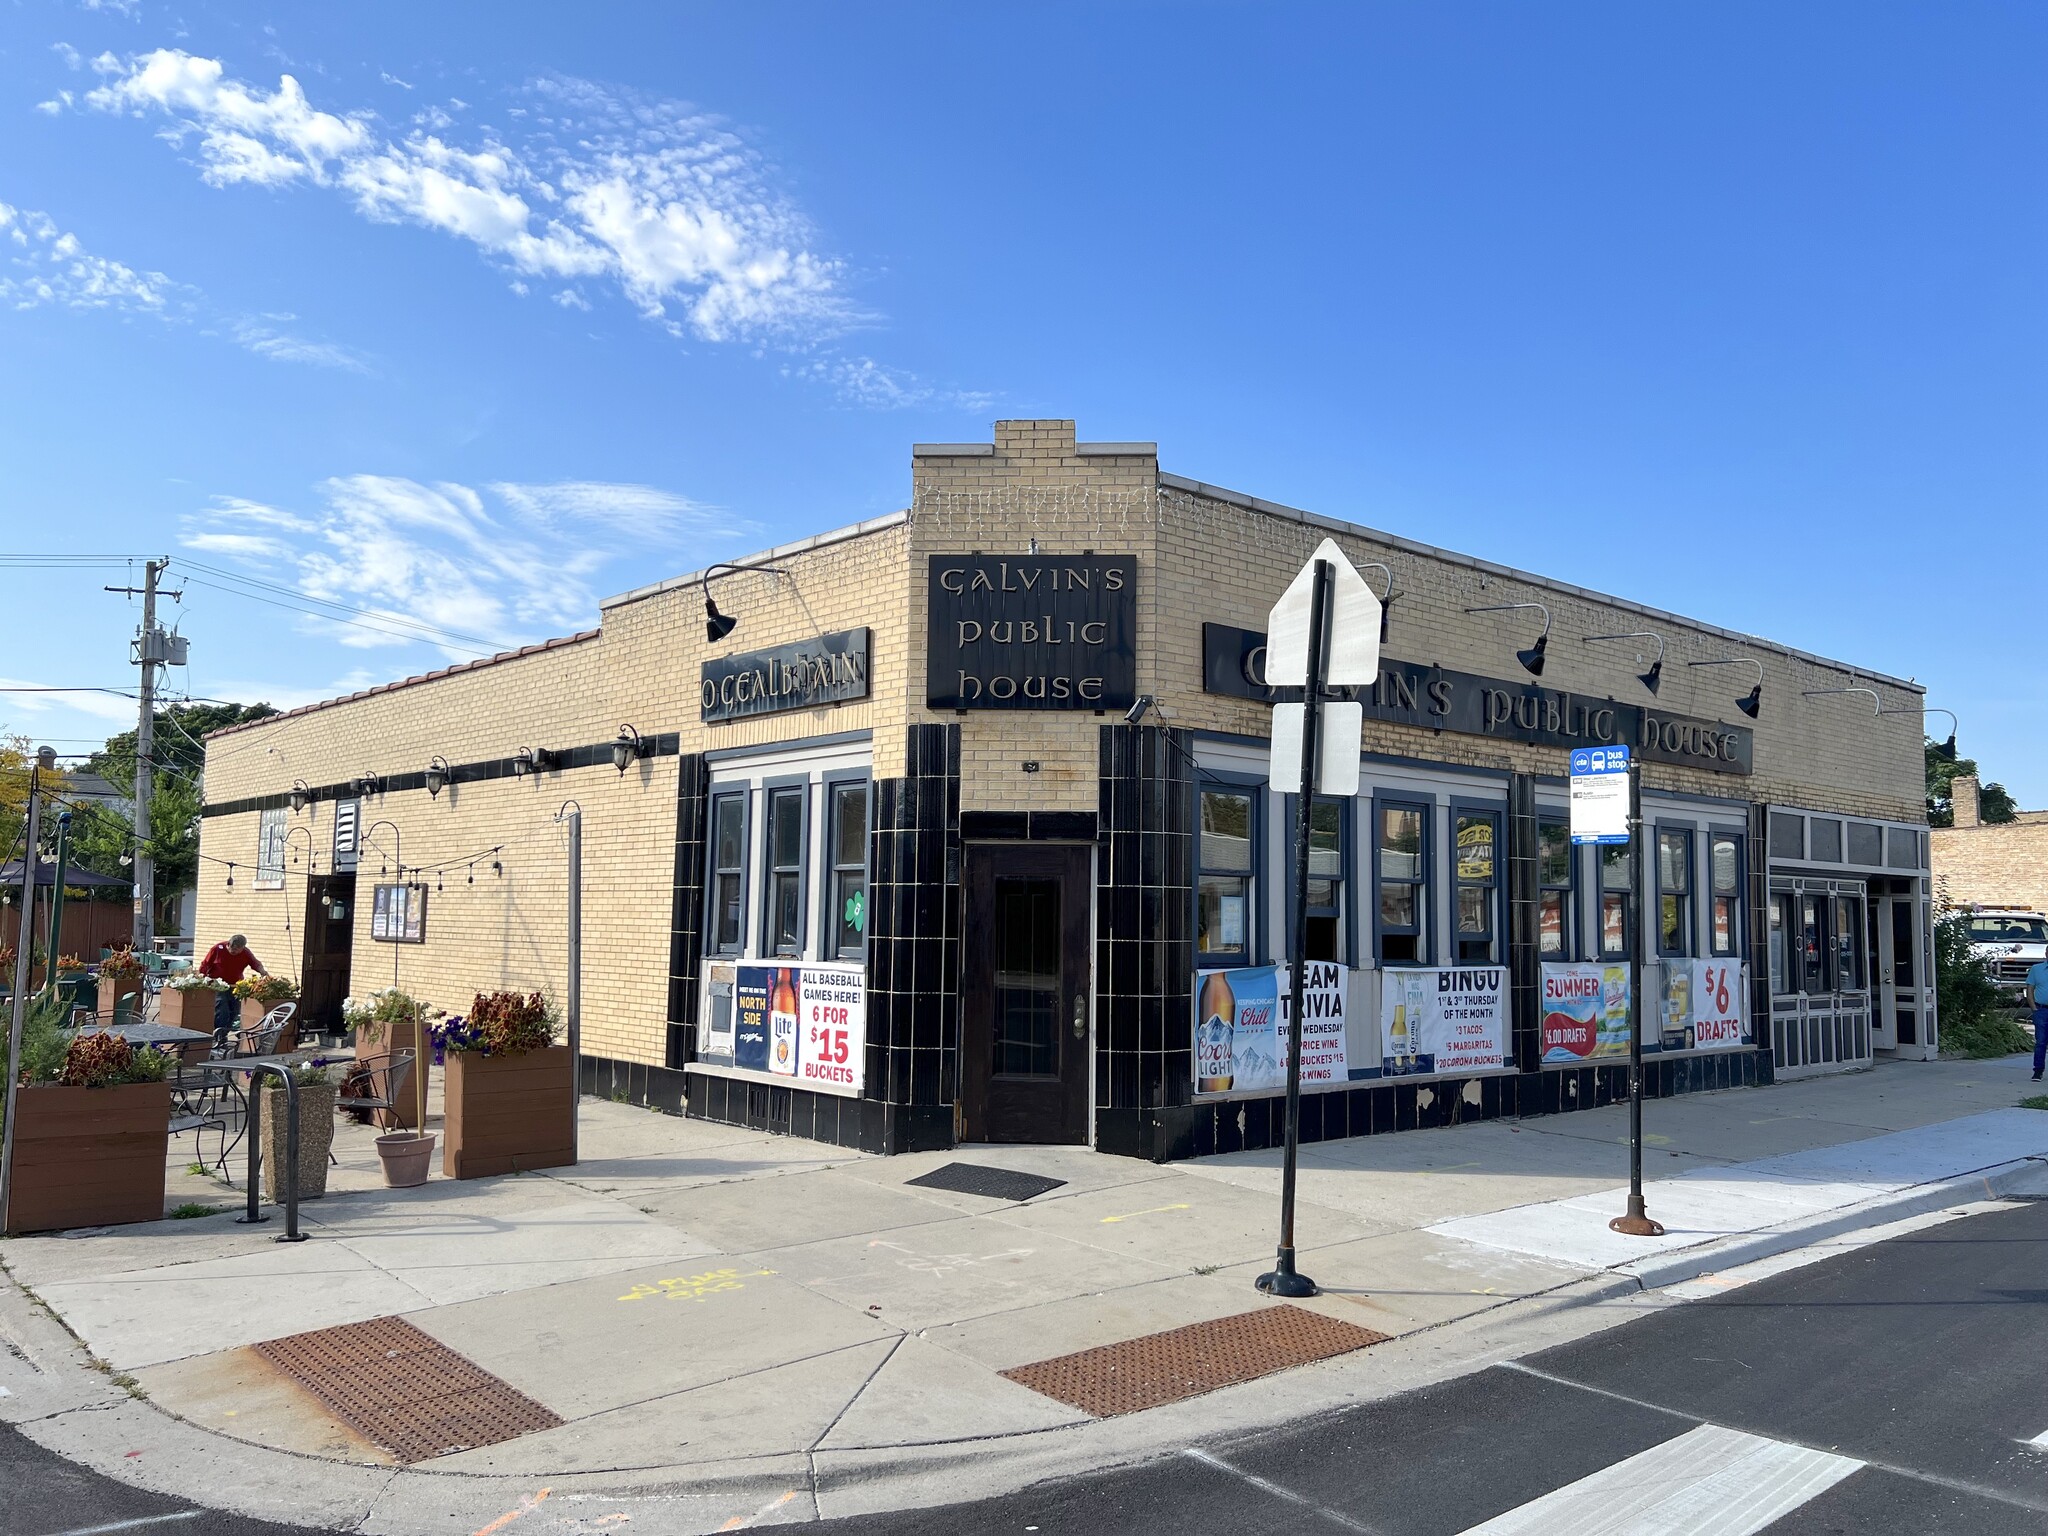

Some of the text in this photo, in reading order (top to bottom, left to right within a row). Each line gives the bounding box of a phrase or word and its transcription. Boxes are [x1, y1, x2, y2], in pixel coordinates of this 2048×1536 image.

[940, 562, 1124, 597] GALVIN'S
[956, 616, 1106, 648] PUBLIC
[959, 669, 1104, 700] HOUSE
[1489, 688, 1614, 741] PUBLIC
[1644, 708, 1738, 762] HOUSE
[1607, 750, 1623, 759] bus
[1607, 760, 1626, 770] stop
[803, 973, 862, 987] ALL BASEBALL
[1546, 978, 1599, 998] SUMMER
[1705, 966, 1729, 1014] $6
[740, 996, 766, 1010] NORTH
[804, 989, 860, 1003] GAMES HERE!
[1464, 995, 1498, 1005] THURSDAY
[743, 1011, 761, 1026] SIDE
[813, 1005, 848, 1025] 6 FOR
[1241, 1007, 1270, 1026] Chill
[1444, 1008, 1493, 1019] OF THE MONTH
[775, 1016, 792, 1038] Lite
[1303, 1023, 1343, 1034] WEDNESDAY
[1464, 1025, 1483, 1035] TACOS
[1697, 1019, 1739, 1042] DRAFTS
[1563, 1028, 1587, 1043] DRAFTS
[810, 1025, 849, 1064] $15
[1198, 1036, 1232, 1060] Coors
[1321, 1039, 1338, 1049] WINE
[1454, 1040, 1493, 1051] MARGARITAS
[1200, 1061, 1230, 1075] LIGHT
[1280, 1058, 1284, 1067] 6
[1301, 1055, 1332, 1065] BUCKETS
[1447, 1056, 1473, 1067] CORONA
[1474, 1055, 1502, 1065] BUCKETS
[805, 1062, 853, 1083] BUCKETS
[1307, 1070, 1331, 1079] WINGS
